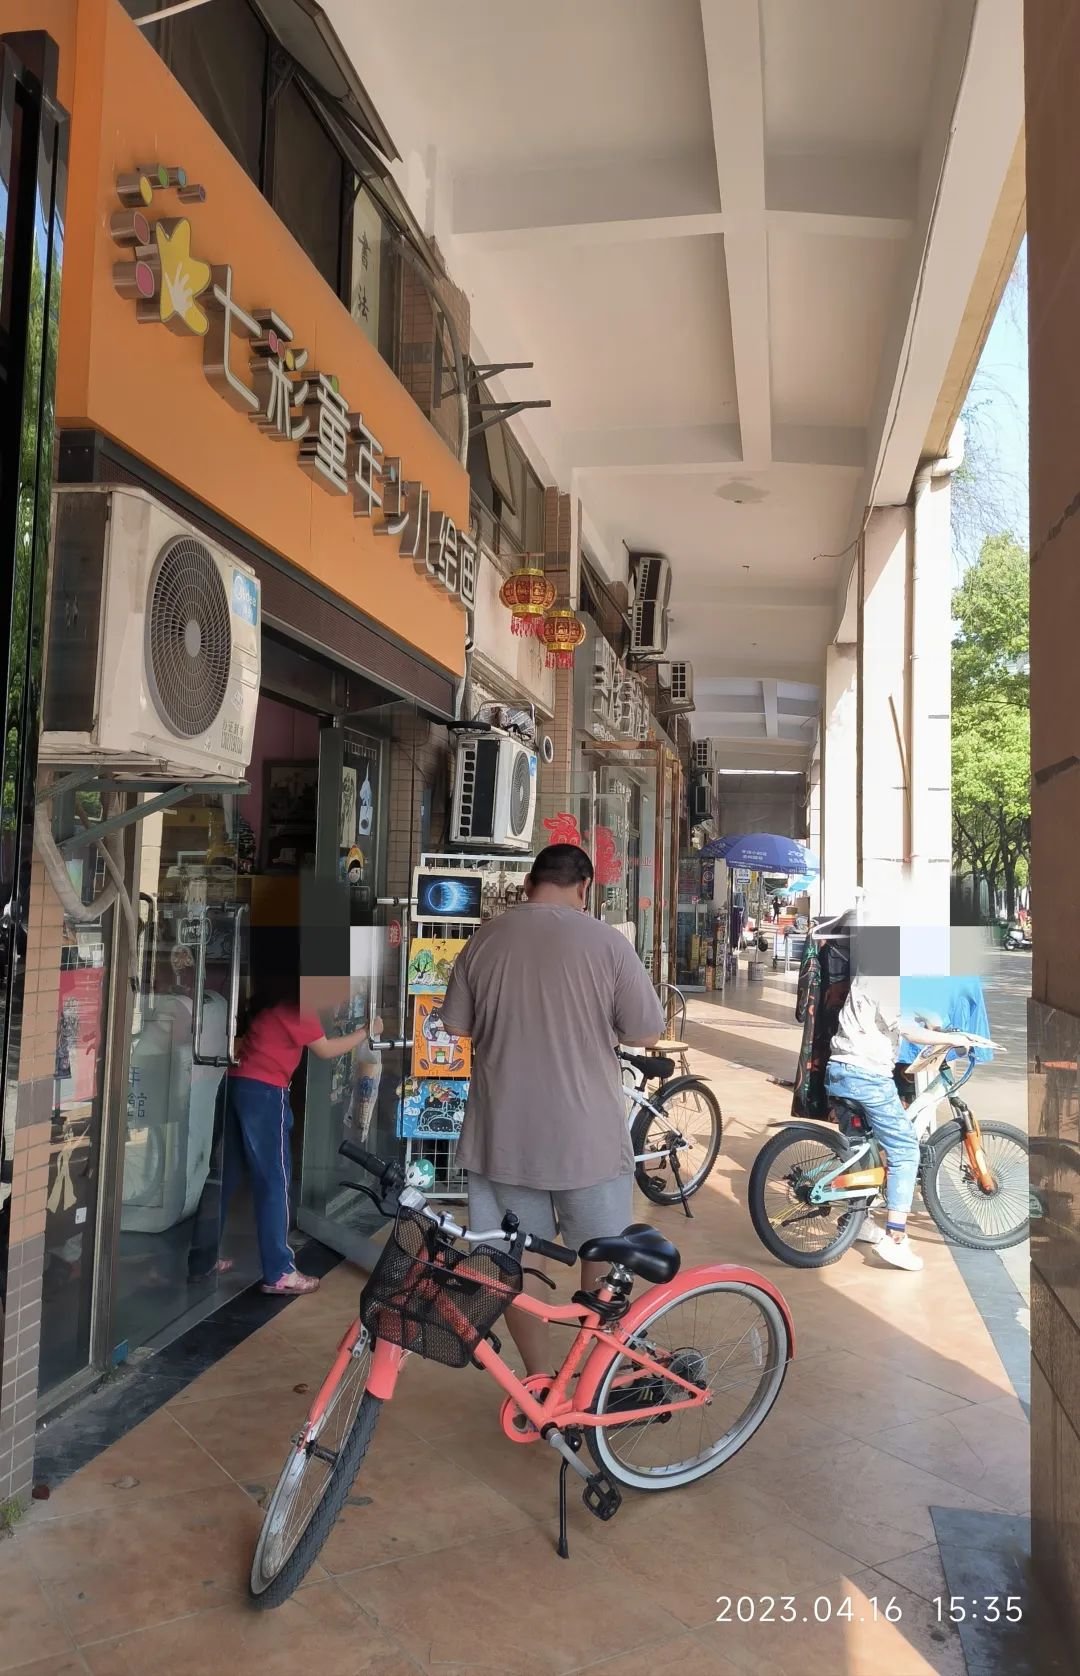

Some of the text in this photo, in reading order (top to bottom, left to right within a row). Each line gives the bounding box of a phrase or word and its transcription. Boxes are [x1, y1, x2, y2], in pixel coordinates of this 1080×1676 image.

[211, 263, 477, 609] 七彩童年少儿绘画
